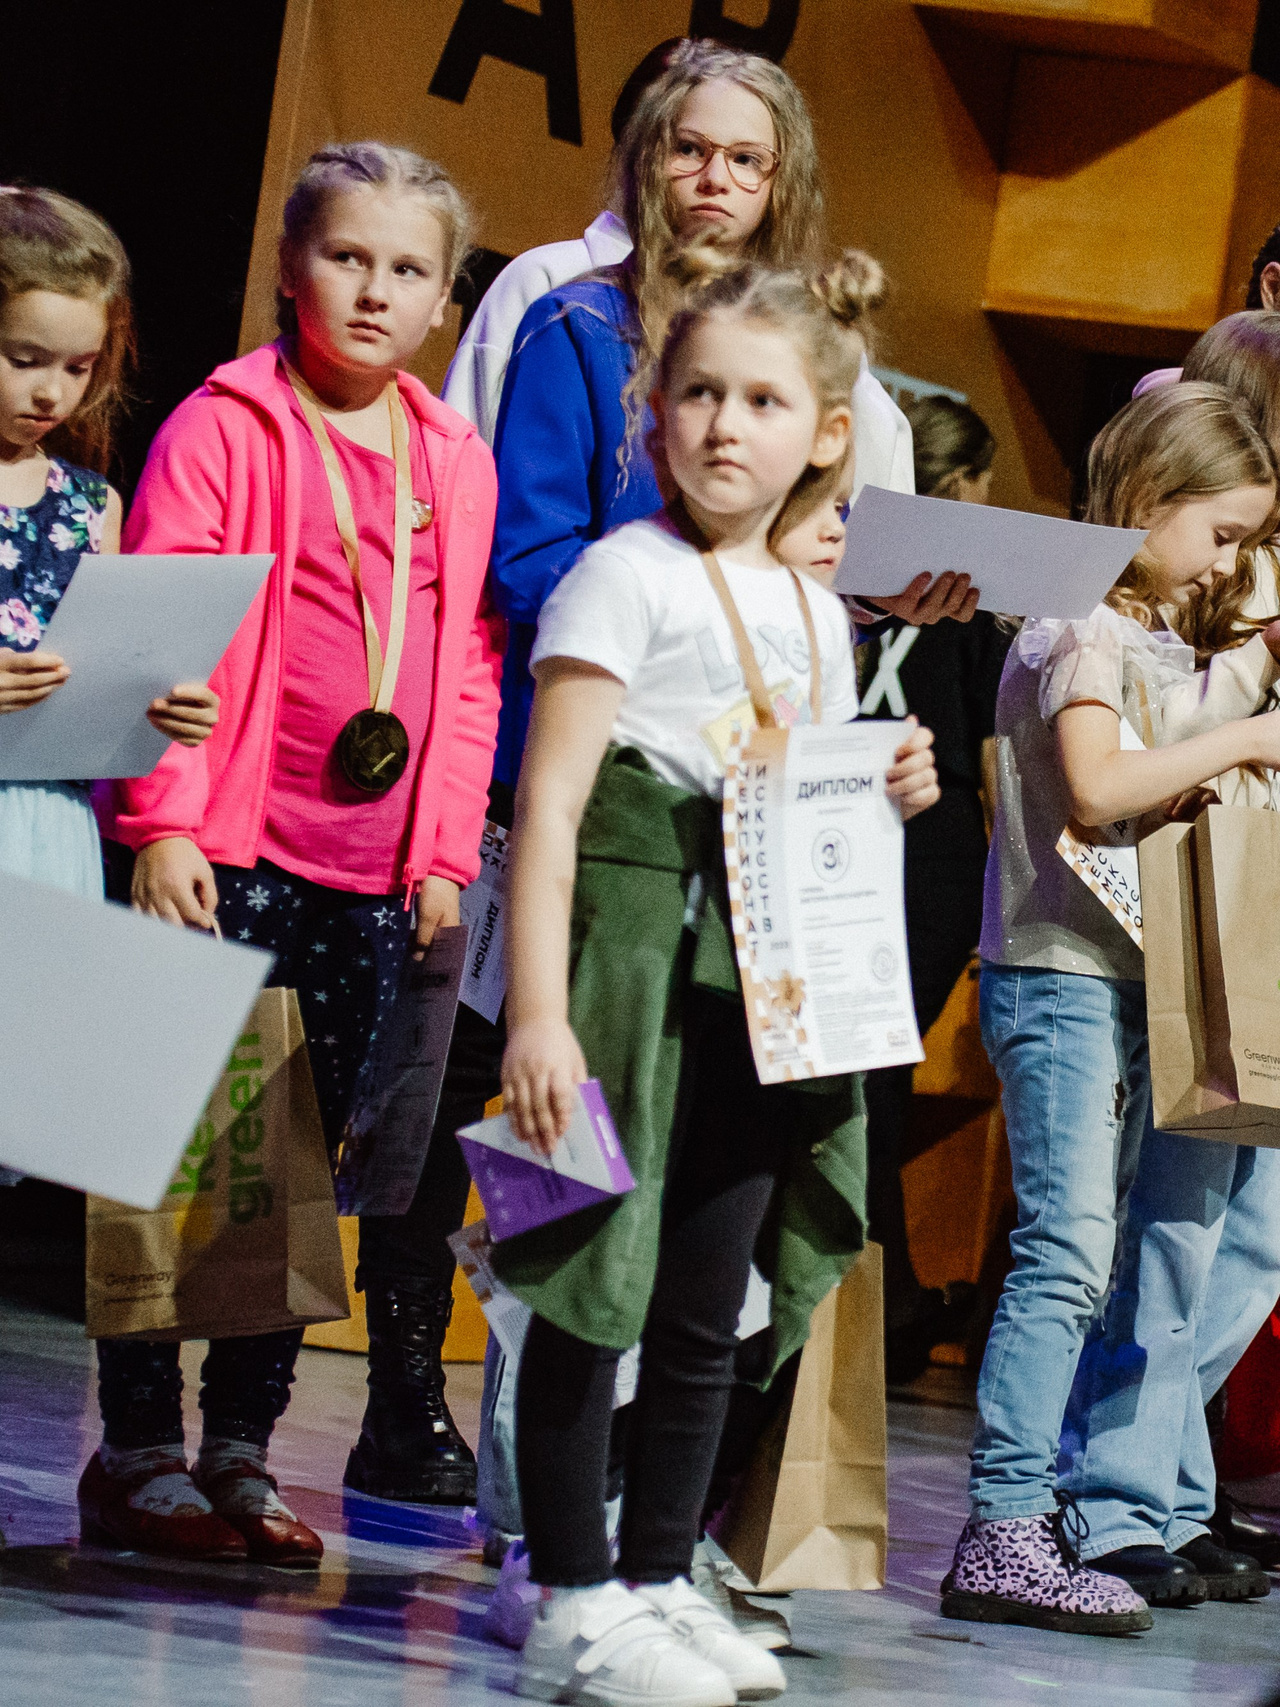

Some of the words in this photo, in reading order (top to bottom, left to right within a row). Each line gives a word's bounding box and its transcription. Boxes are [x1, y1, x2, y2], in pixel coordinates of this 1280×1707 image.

[796, 776, 874, 801] ДИПЛОМ
[737, 765, 758, 957] ЧЕМПИОНАТ
[754, 765, 773, 933] ИСКУССТВ
[821, 843, 838, 870] 3
[471, 901, 500, 979] ДИПЛОМ
